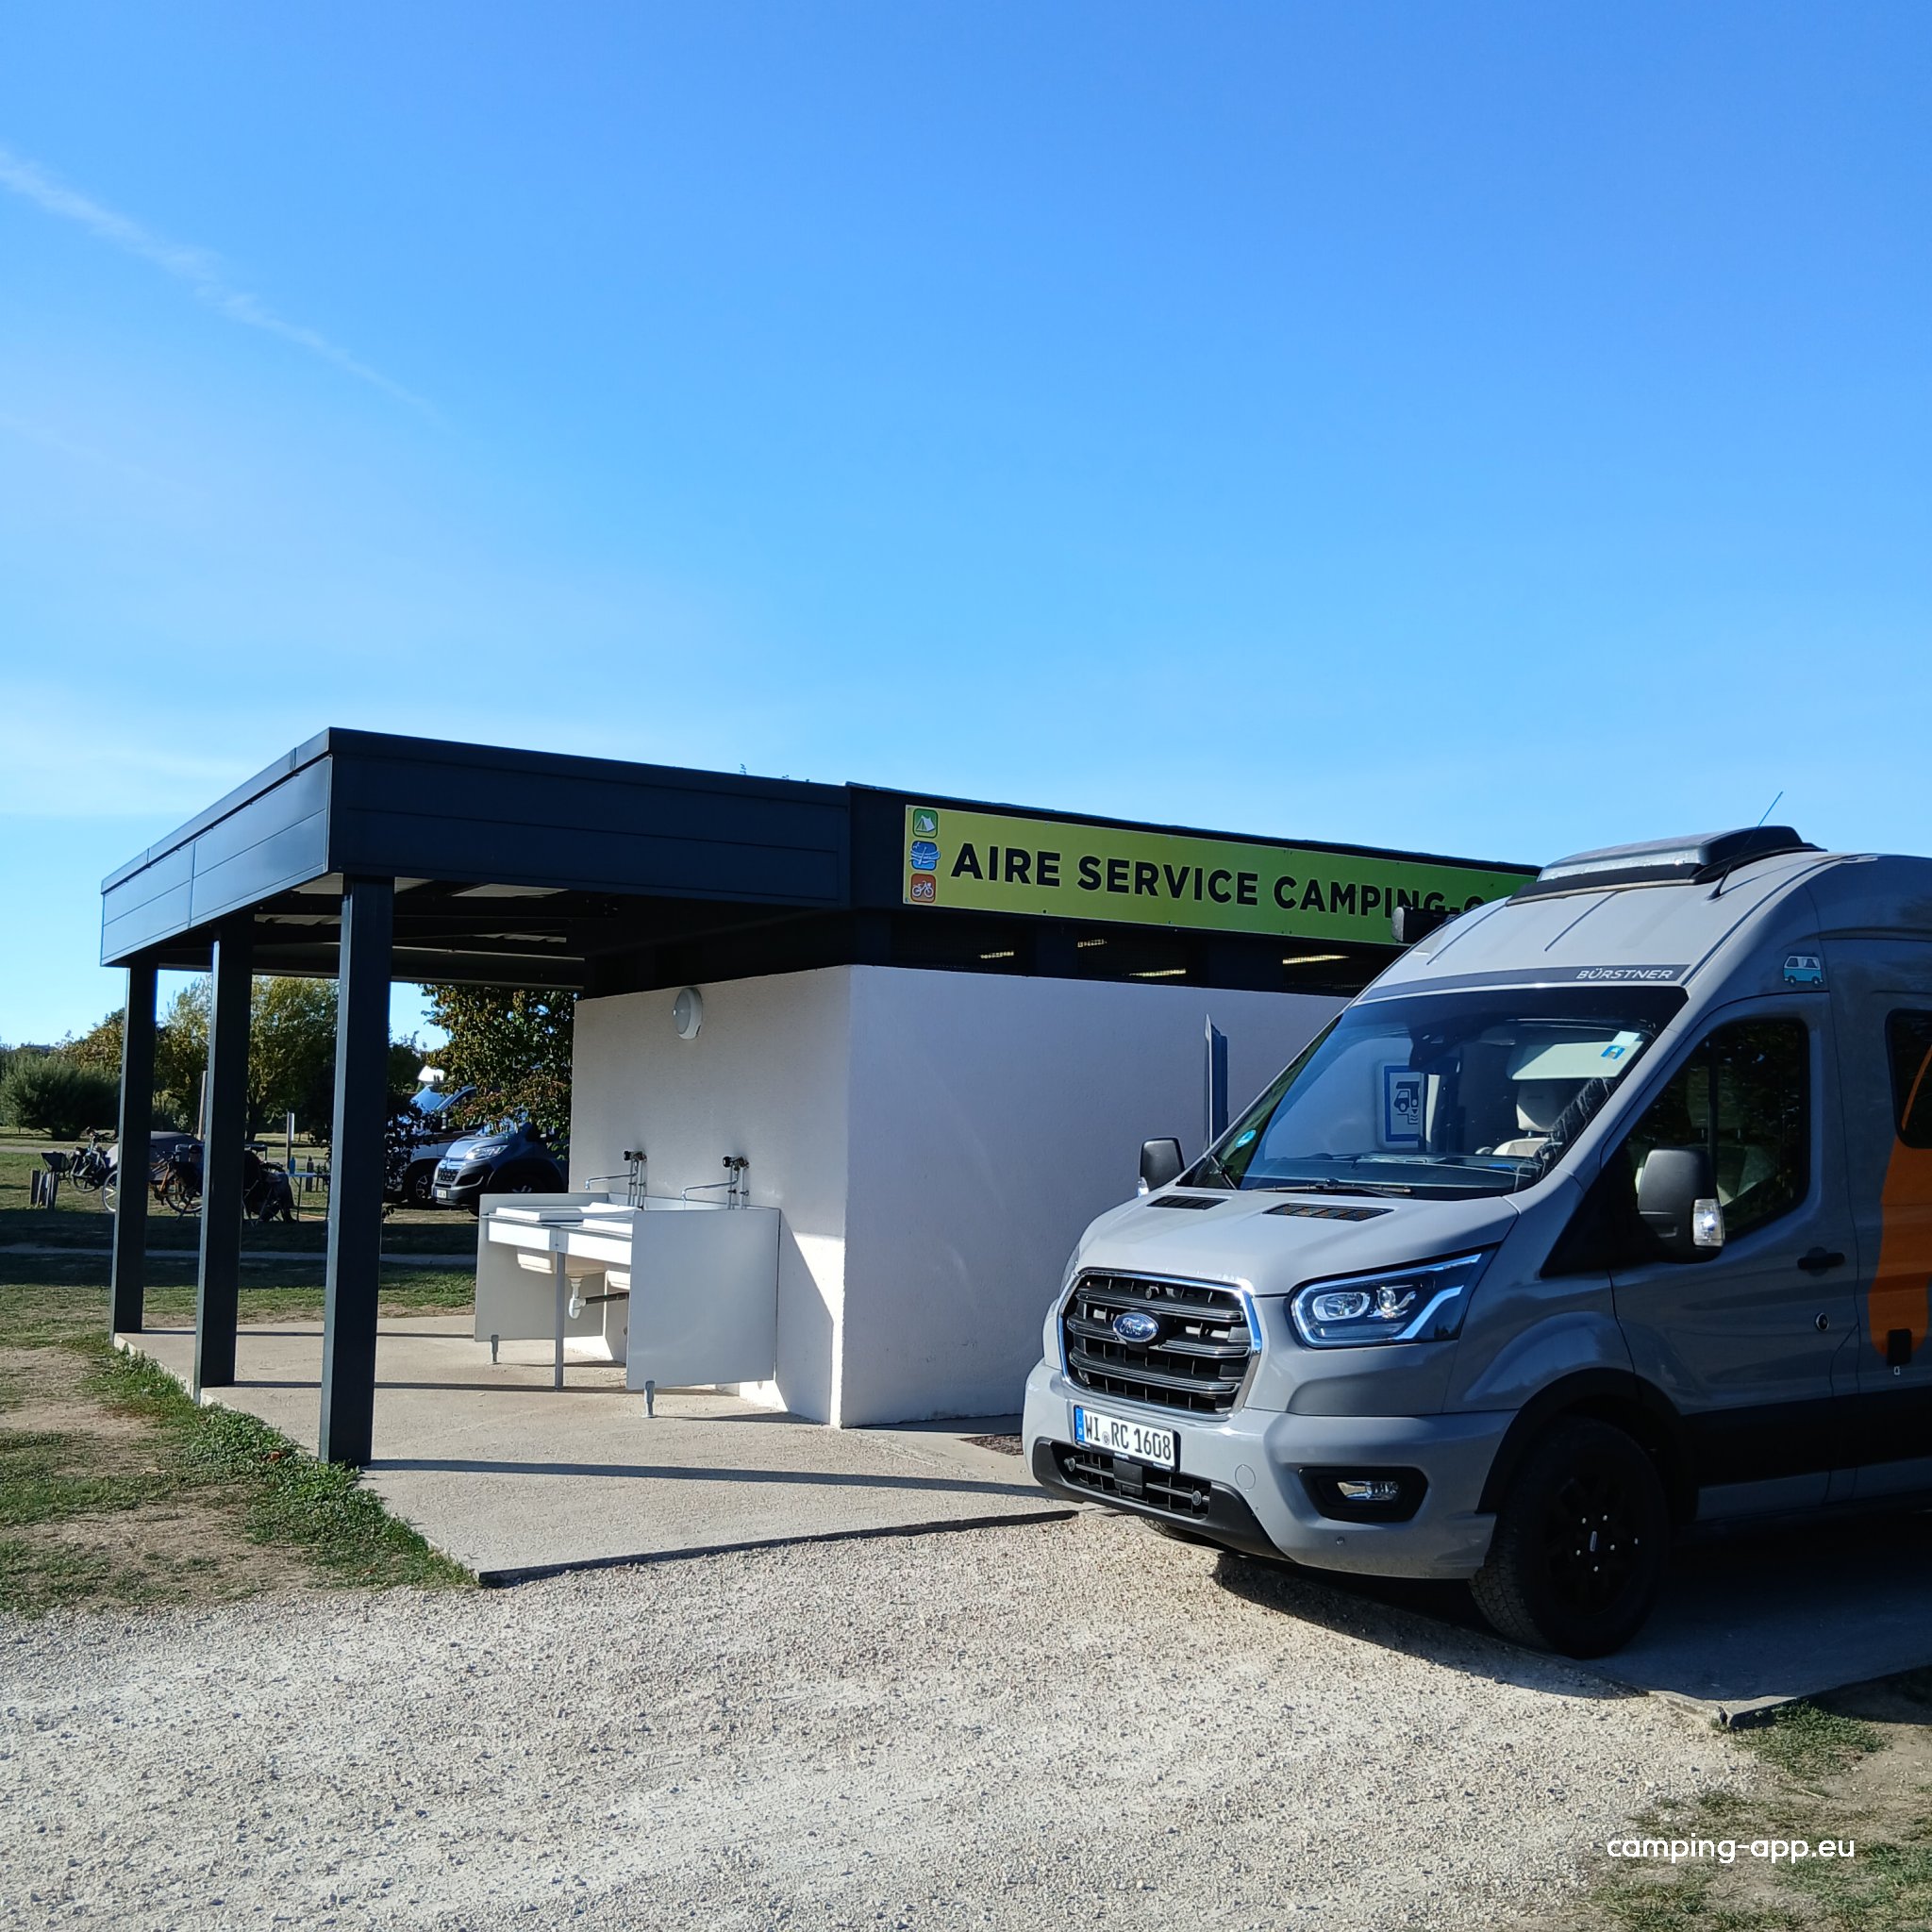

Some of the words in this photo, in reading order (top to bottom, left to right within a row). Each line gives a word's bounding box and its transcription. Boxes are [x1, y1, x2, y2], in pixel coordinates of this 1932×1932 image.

[950, 842, 1061, 887] AIRE
[1076, 855, 1258, 906] SERVICE
[1575, 967, 1674, 980] BÜRSTNER
[1085, 1414, 1101, 1441] WI
[1110, 1421, 1130, 1450] RC
[1134, 1428, 1173, 1460] 1608
